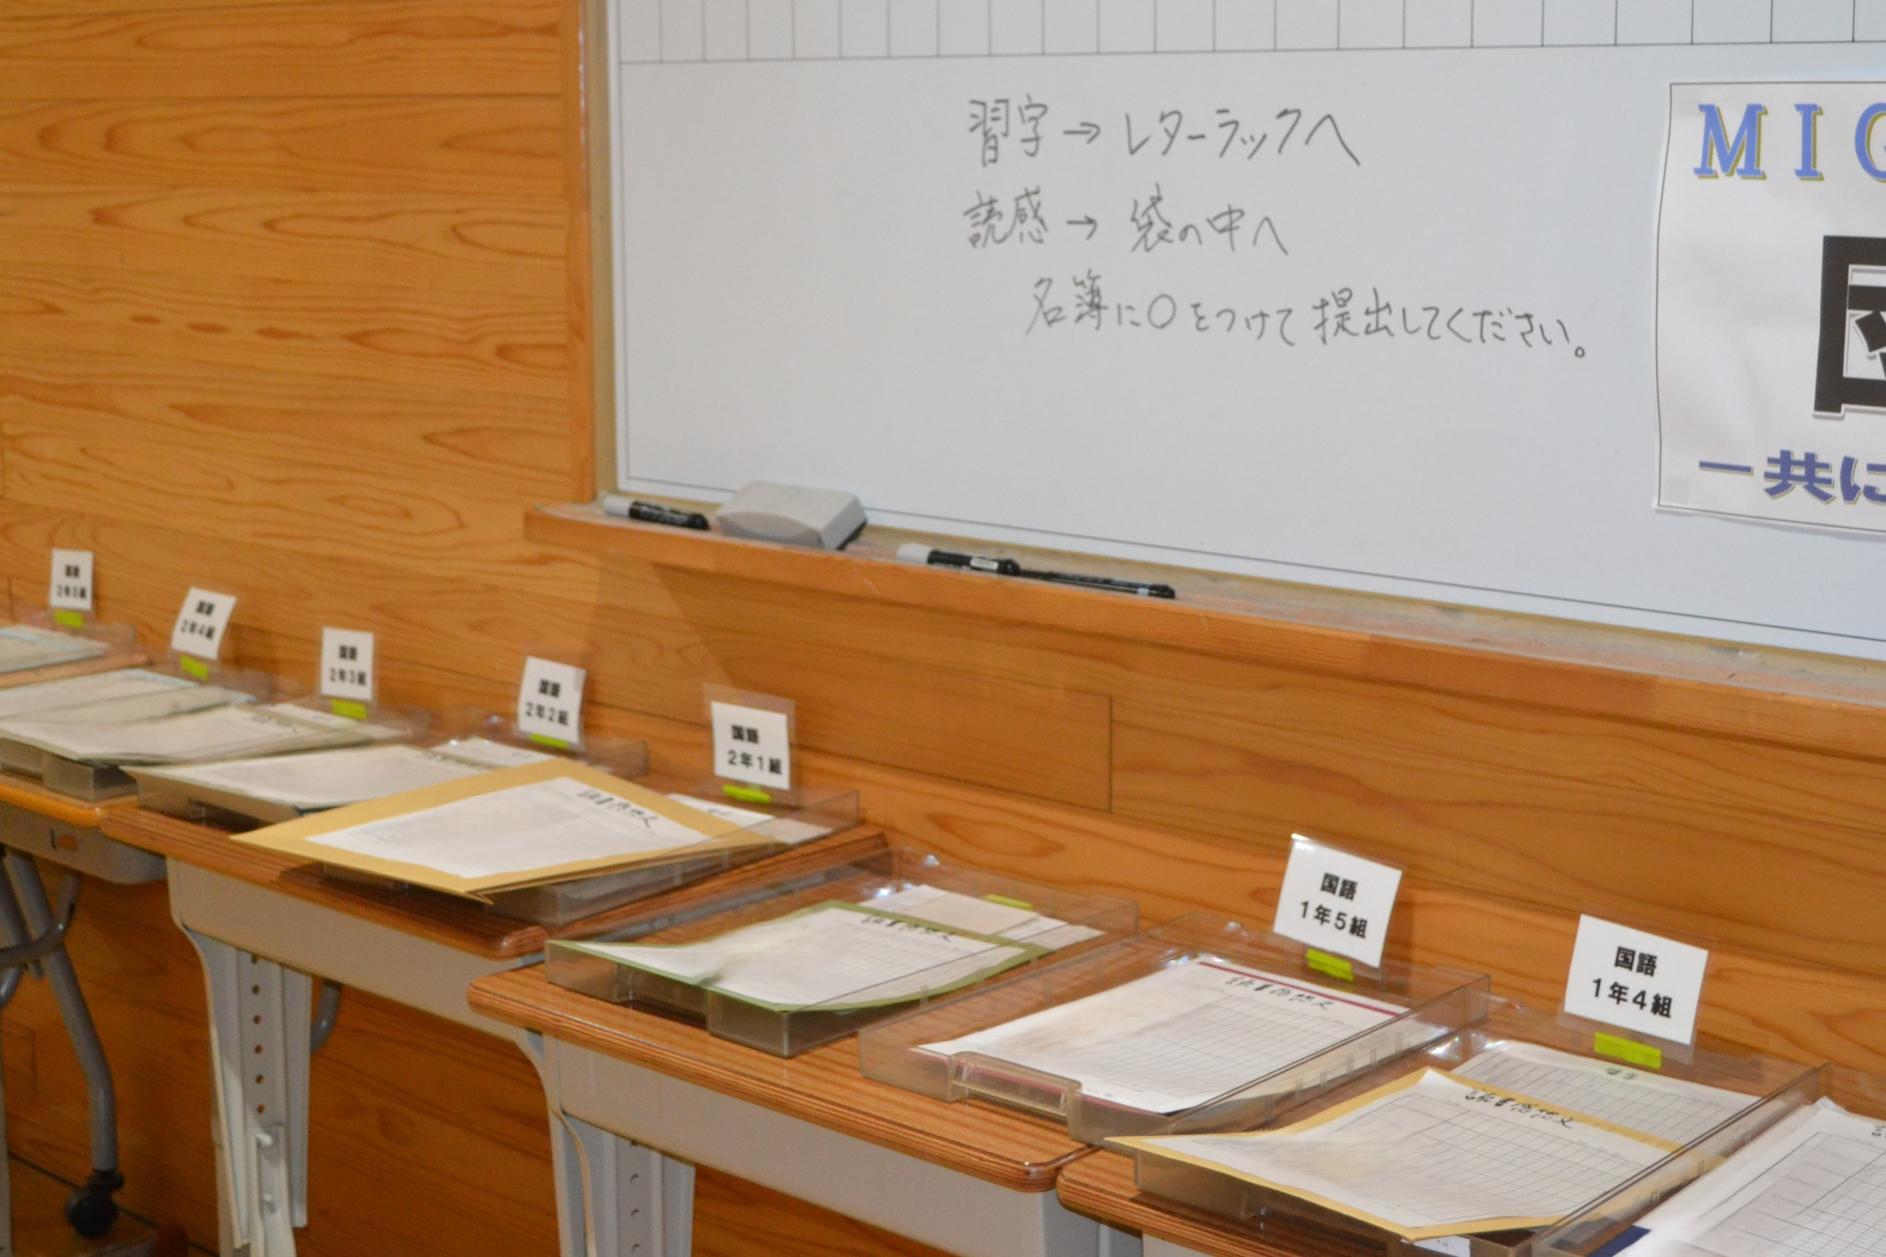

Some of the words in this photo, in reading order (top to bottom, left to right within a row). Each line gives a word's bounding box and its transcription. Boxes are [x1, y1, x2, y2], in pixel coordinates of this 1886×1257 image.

[968, 94, 1049, 168] 習字
[1129, 182, 1290, 257] 袋の中へ
[727, 748, 783, 776] 2年1組
[1320, 872, 1358, 902] 国語
[1300, 900, 1369, 940] 1年5組
[1614, 945, 1658, 978] 国語
[1592, 976, 1673, 1019] 1年4組
